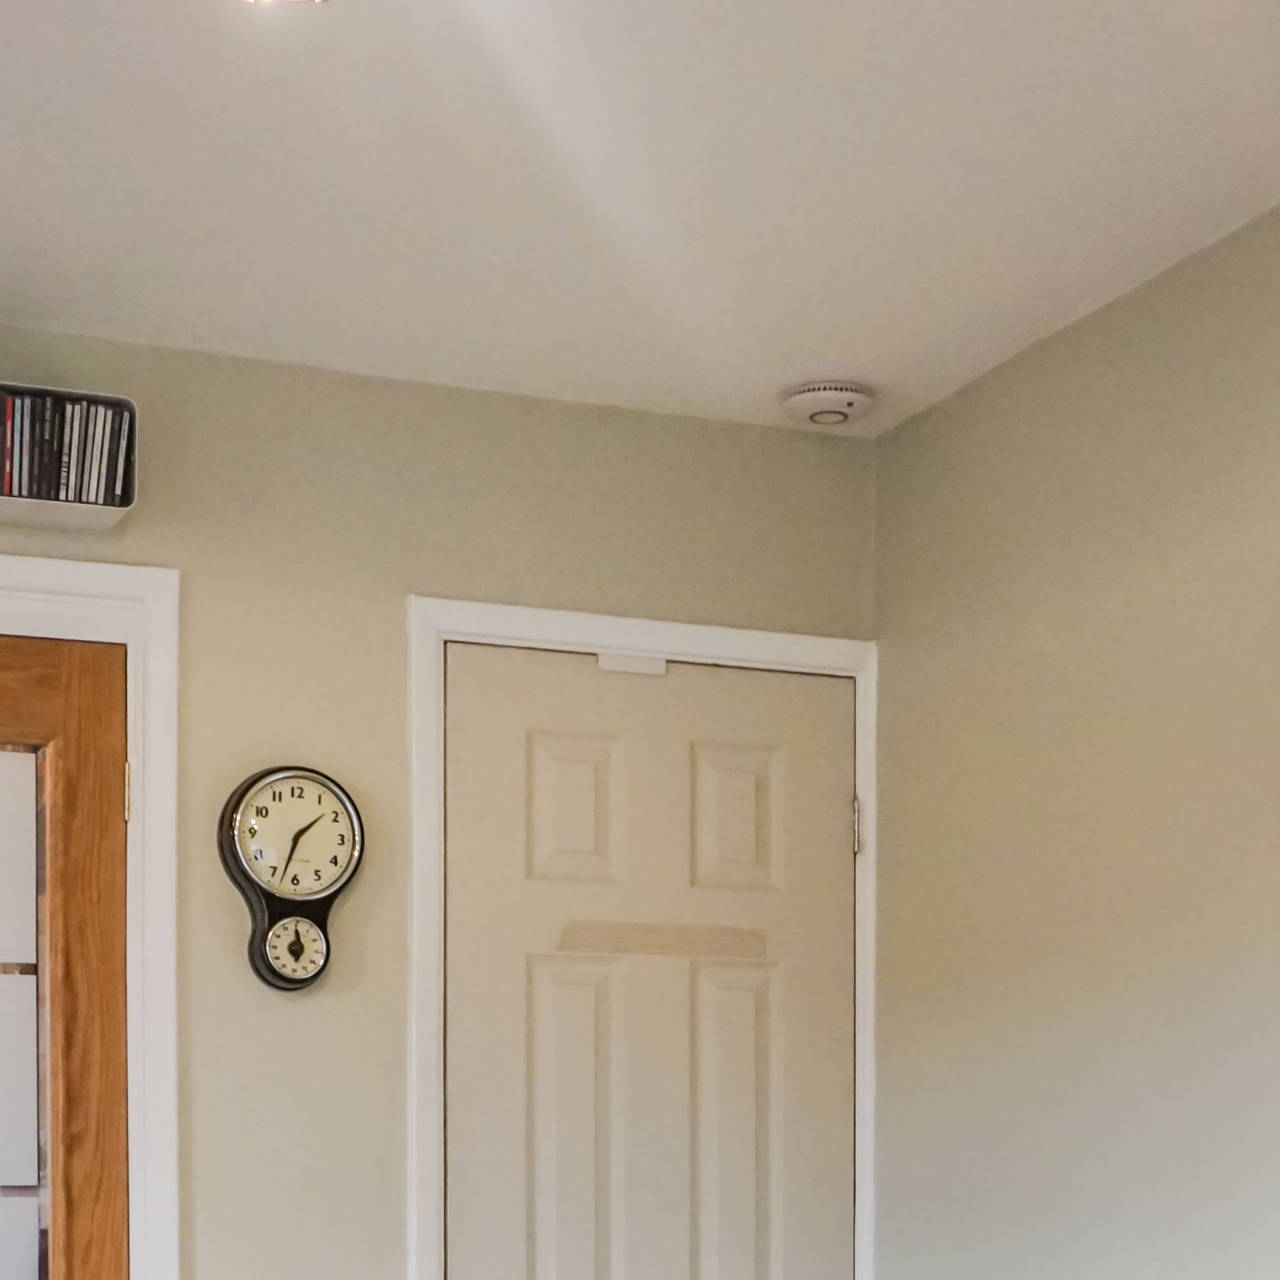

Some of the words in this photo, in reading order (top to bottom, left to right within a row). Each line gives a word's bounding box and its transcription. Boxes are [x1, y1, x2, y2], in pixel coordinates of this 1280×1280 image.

[272, 791, 282, 802] 11
[290, 786, 304, 799] 12
[317, 794, 322, 805] 1
[255, 806, 269, 818] 10
[331, 811, 340, 823] 2
[248, 826, 258, 839] 9
[337, 834, 345, 846] 3
[329, 855, 338, 867] 4
[269, 866, 278, 878] 7
[313, 870, 322, 882] 5
[291, 874, 300, 887] 6
